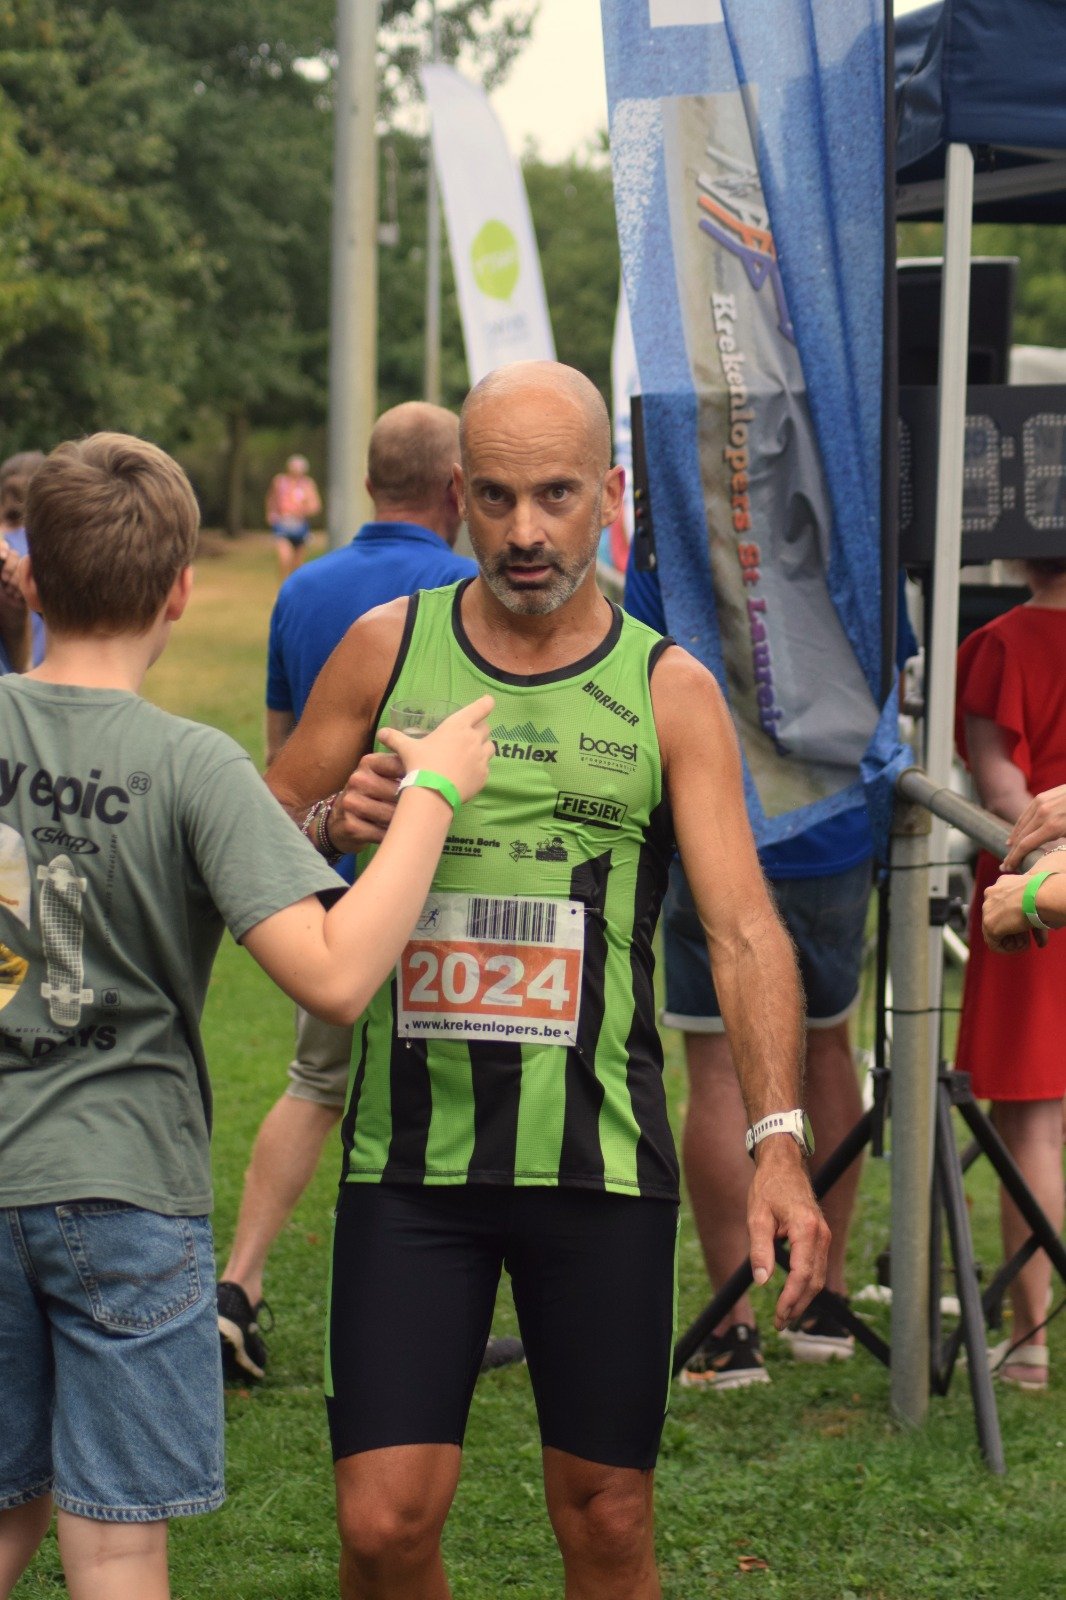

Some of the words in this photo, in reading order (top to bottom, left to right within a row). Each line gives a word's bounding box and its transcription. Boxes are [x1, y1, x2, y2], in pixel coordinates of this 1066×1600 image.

[738, 543, 761, 587] St
[582, 680, 640, 727] BIORACER
[579, 732, 639, 762] boest
[30, 768, 131, 825] epic
[131, 775, 149, 792] 83
[562, 797, 622, 821] FIESIEK
[477, 837, 500, 848] Boris
[408, 951, 570, 1011] 2024
[412, 1019, 562, 1038] www.krekenlopers.be
